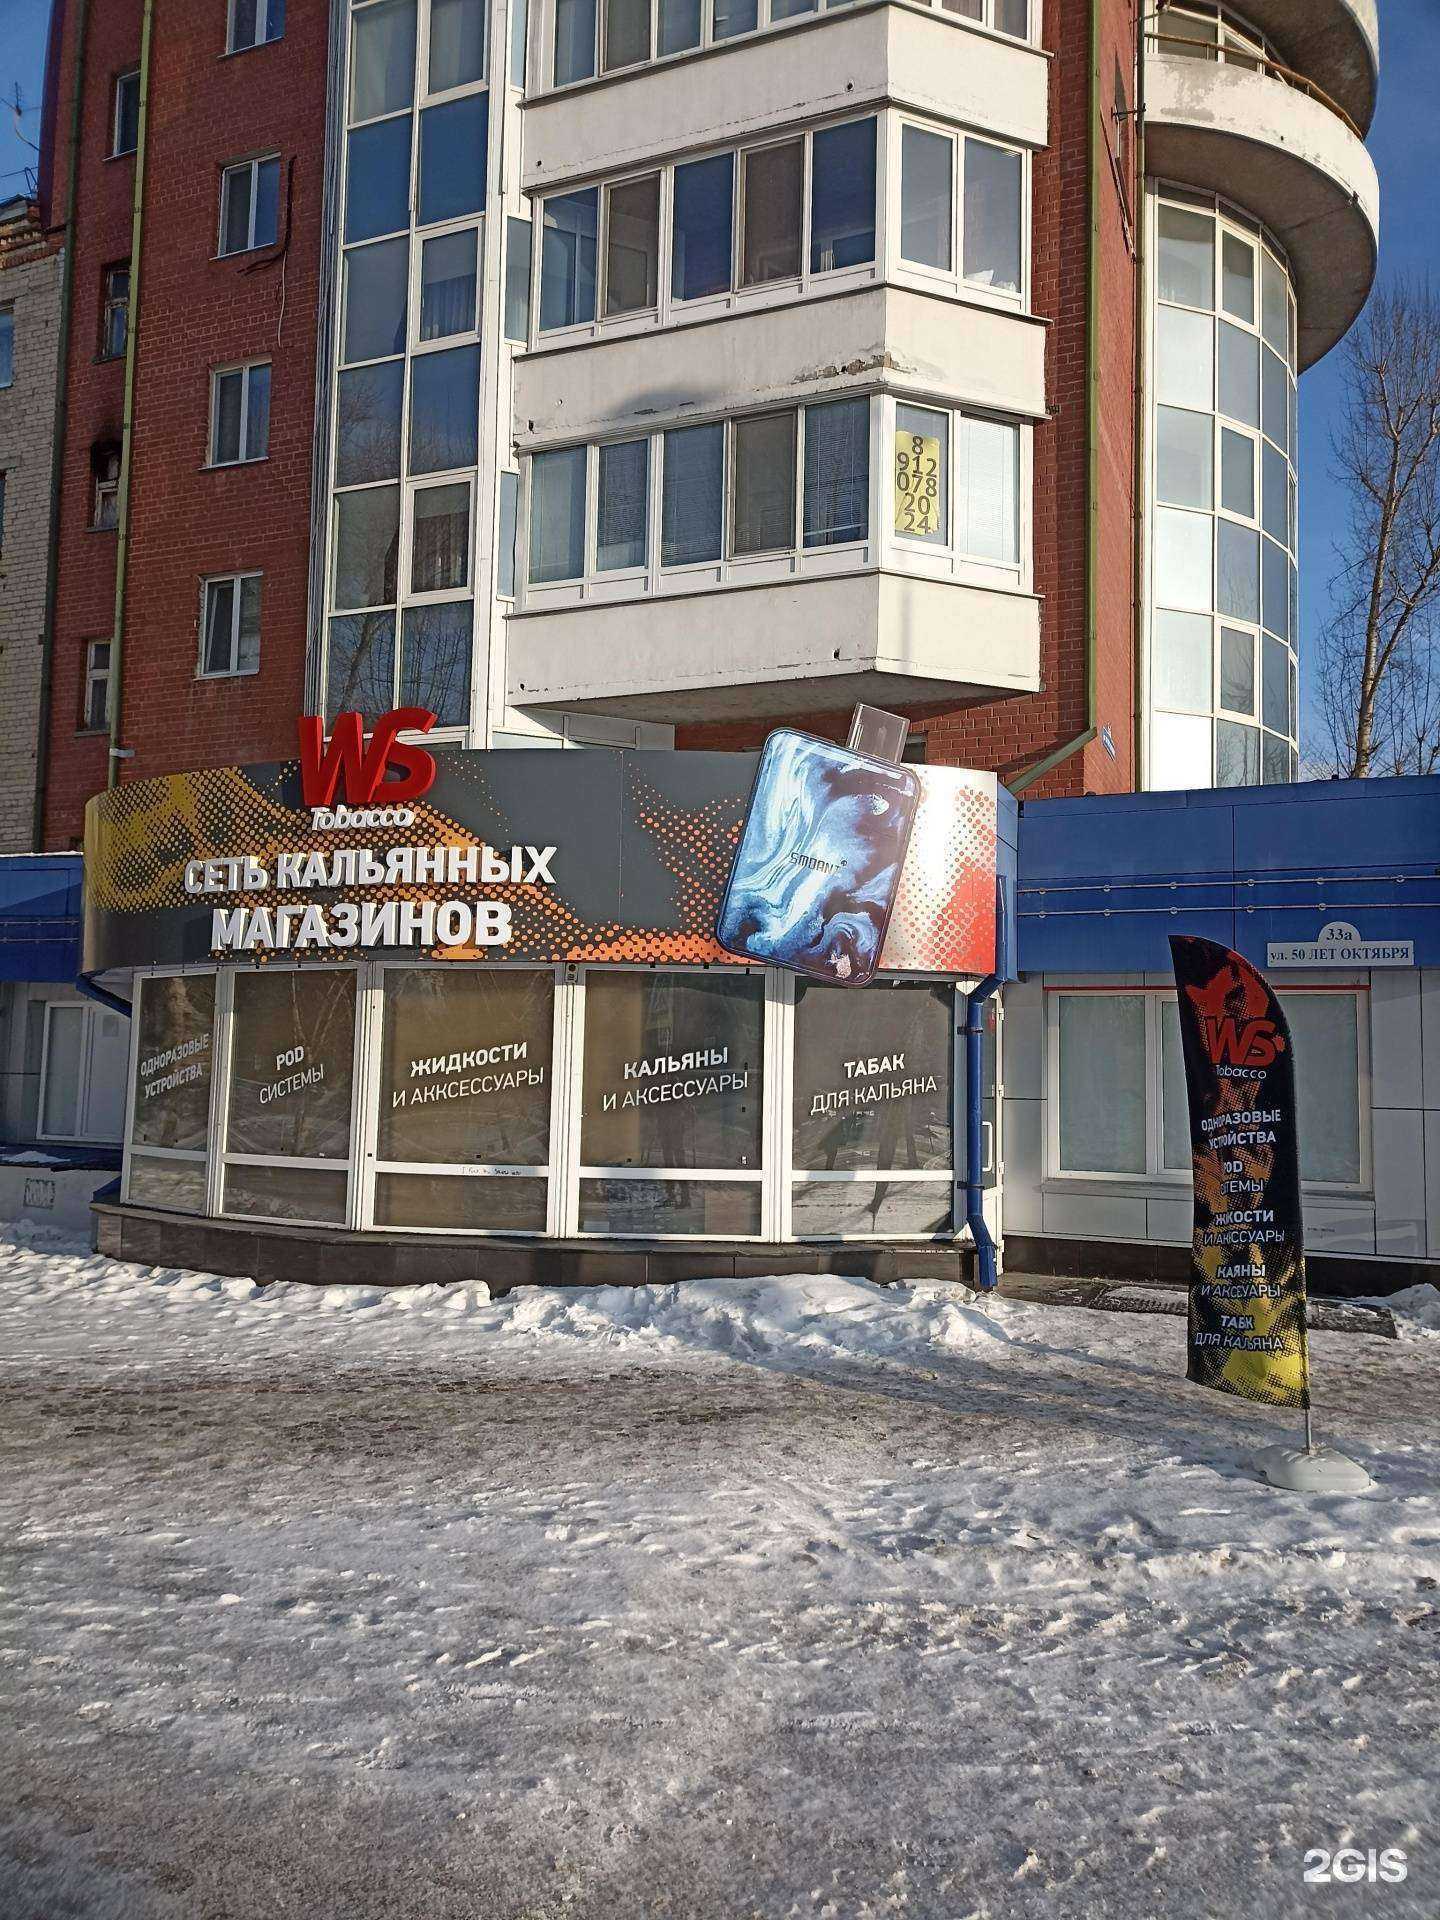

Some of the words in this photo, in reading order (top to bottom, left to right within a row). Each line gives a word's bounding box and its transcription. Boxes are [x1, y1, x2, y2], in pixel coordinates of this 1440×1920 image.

[912, 436, 923, 455] 8
[897, 452, 937, 478] 912
[897, 472, 937, 497] 078
[905, 493, 930, 515] 20
[904, 512, 930, 534] 24
[300, 707, 438, 806] WS
[311, 805, 415, 831] Tobacco
[184, 855, 268, 894] СЕТЬ
[277, 846, 557, 889] КАЛЬЯННЫХ
[211, 901, 512, 950] МАГАЗИНОВ
[1326, 928, 1353, 941] 33а
[1271, 951, 1288, 963] ул.
[1291, 949, 1306, 960] 50
[1309, 948, 1335, 960] ЛЕТ
[1341, 947, 1409, 960] ОКТЯБРЯ
[1207, 1016, 1278, 1067] WS
[140, 1033, 210, 1077] ОДНОРАЗОВЫЕ
[276, 1045, 304, 1071] POD
[410, 1042, 528, 1077] ЖИДКОСТИ
[624, 1047, 728, 1080] КАЛЬЯНЫ
[844, 1053, 905, 1078] ТАБАК
[144, 1063, 203, 1099] УСТРОЙСТВА
[259, 1064, 324, 1104] СИСТЕМЫ
[1216, 1064, 1267, 1080] Tobacco
[392, 1090, 406, 1108] И
[411, 1067, 544, 1105] АККСЕССУАРЫ
[603, 1093, 617, 1112] И
[622, 1071, 748, 1108] АКСЕССУАРЫ
[810, 1090, 849, 1115] ДЛЯ
[855, 1076, 937, 1104] КАЛЬЯНА
[1220, 1315, 1254, 1329] ТАБК
[1194, 1332, 1221, 1346] ДЛЯ
